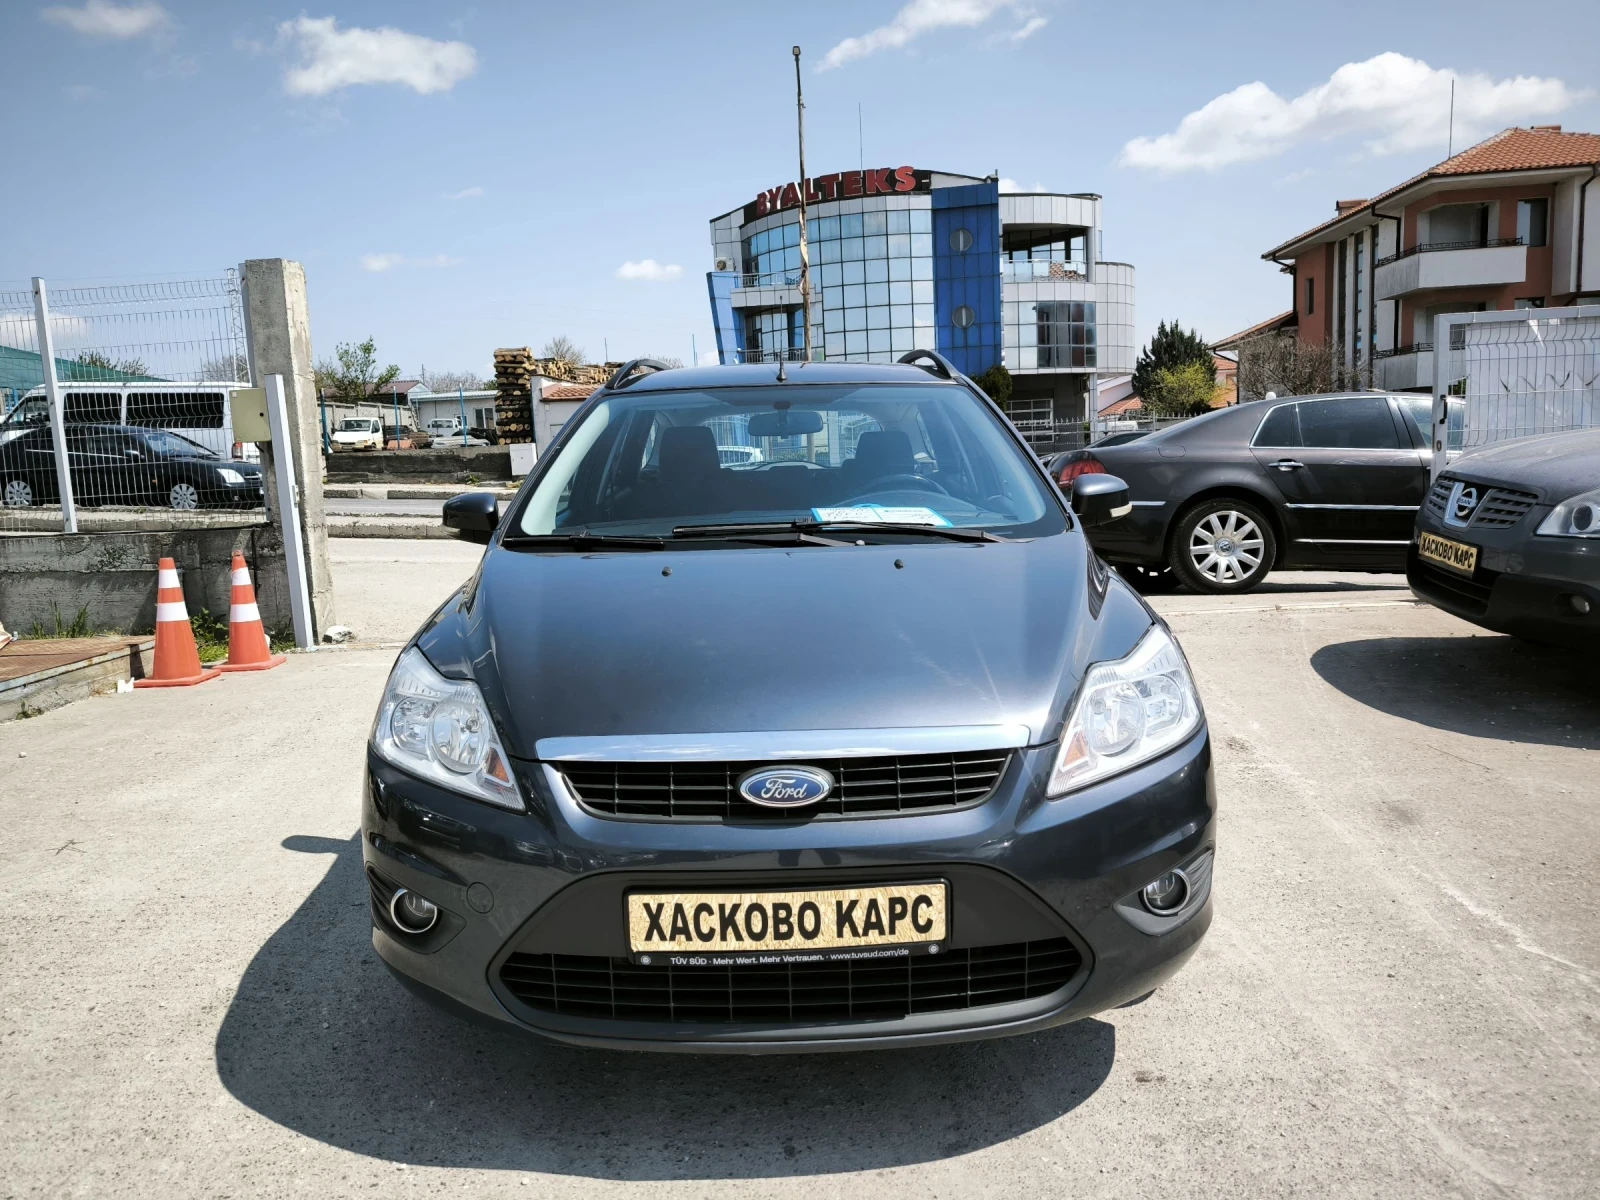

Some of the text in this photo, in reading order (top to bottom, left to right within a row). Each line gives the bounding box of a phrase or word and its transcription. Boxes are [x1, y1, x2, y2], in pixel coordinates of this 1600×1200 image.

[756, 165, 917, 216] BYALTEKS
[761, 778, 808, 799] Ford
[643, 894, 935, 942] ХАСКОВО КАРС
[670, 957, 687, 965] TÜV
[689, 957, 707, 965] SÜD
[713, 957, 734, 965] Mehr
[735, 956, 758, 964] Wert.
[760, 955, 781, 963] Mehr
